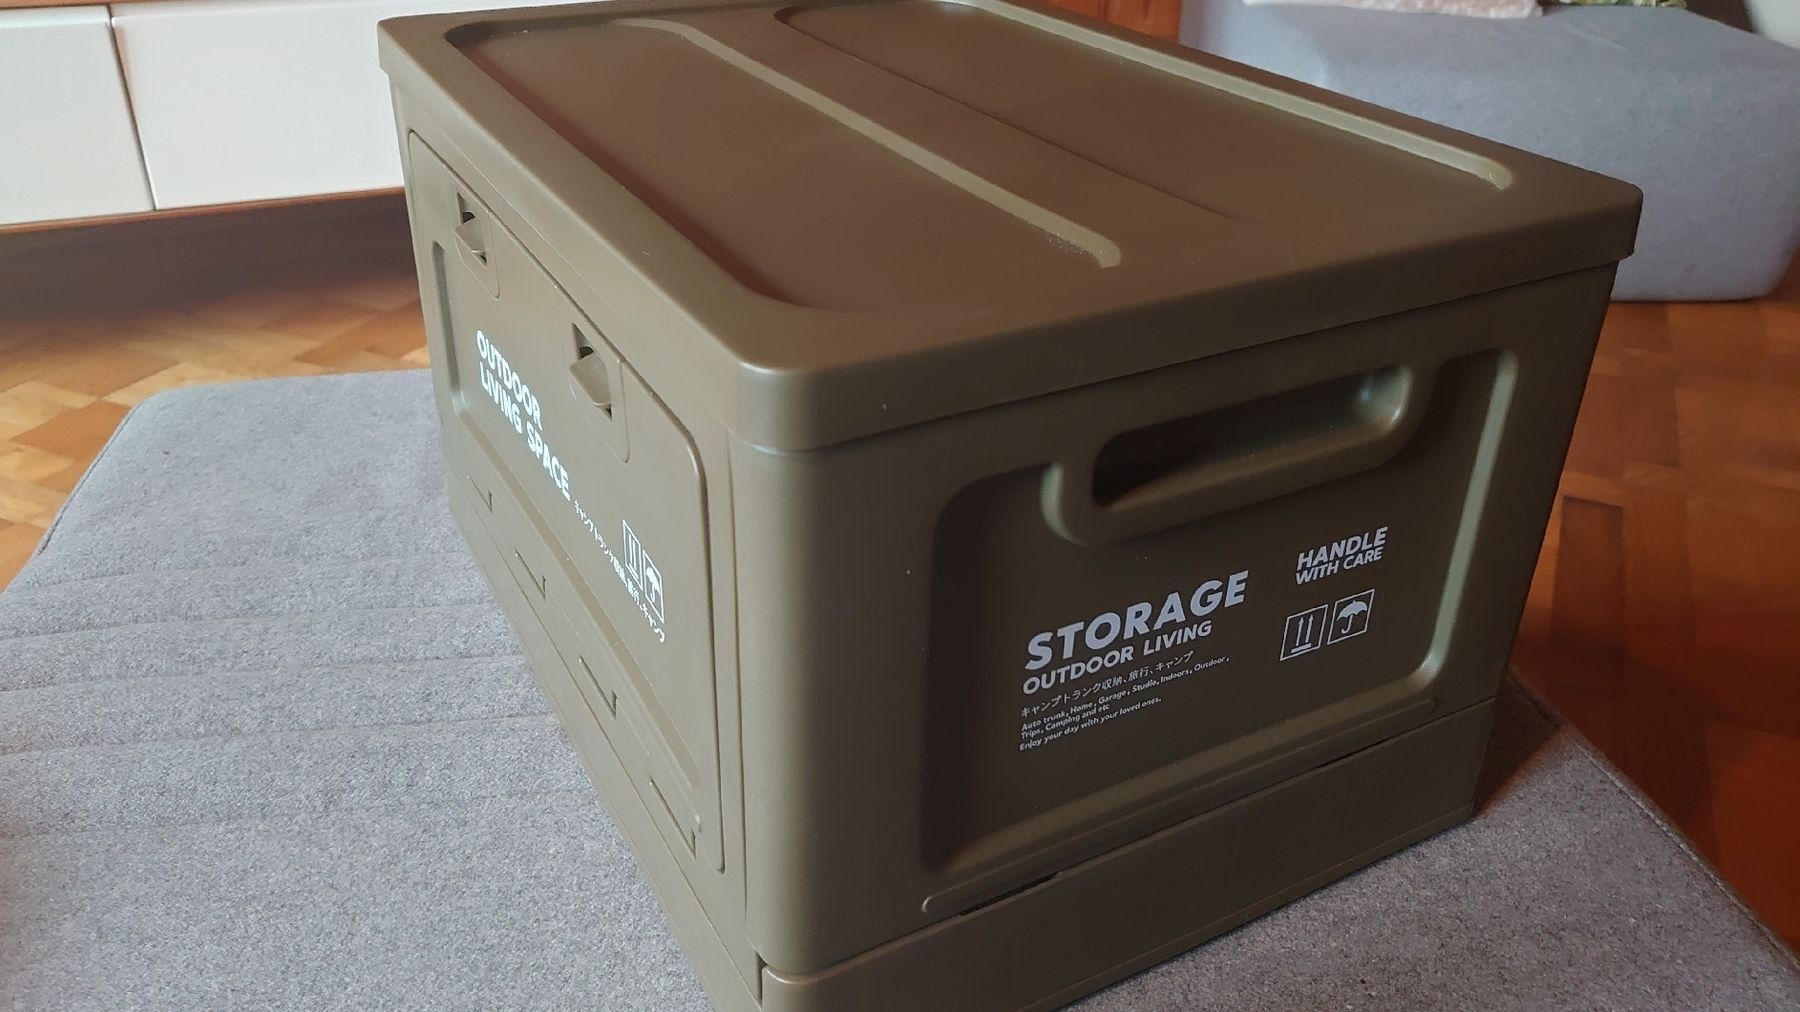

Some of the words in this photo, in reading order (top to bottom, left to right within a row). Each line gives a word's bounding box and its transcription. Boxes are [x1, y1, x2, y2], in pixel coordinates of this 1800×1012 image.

[477, 329, 543, 431] OUTDOOR
[480, 361, 523, 434] LIVING
[526, 421, 571, 502] SPACE
[1295, 560, 1339, 585] WITH
[1343, 546, 1384, 570] CARE
[1296, 526, 1388, 571] HANDLE
[1025, 569, 1249, 671] STORAGE
[1022, 645, 1134, 695] OUTDOOR
[1143, 620, 1212, 656] LIVING
[1020, 738, 1042, 751] Enjoy
[1043, 731, 1063, 744] your
[1064, 725, 1080, 735] day
[1081, 717, 1099, 729] with
[1100, 711, 1119, 724] your
[1119, 702, 1141, 715] loved
[1141, 697, 1162, 707] ones.
[1021, 720, 1042, 732] Auto
[1043, 710, 1069, 724] trunk,
[1070, 702, 1097, 714] Home,
[1098, 690, 1130, 704] Garage,
[1132, 679, 1160, 693] Studio,
[1160, 669, 1193, 683] Indoors,
[1021, 728, 1044, 739] Trips,
[1045, 715, 1081, 731] Camping
[1081, 705, 1097, 719] and
[1098, 703, 1110, 713] etc
